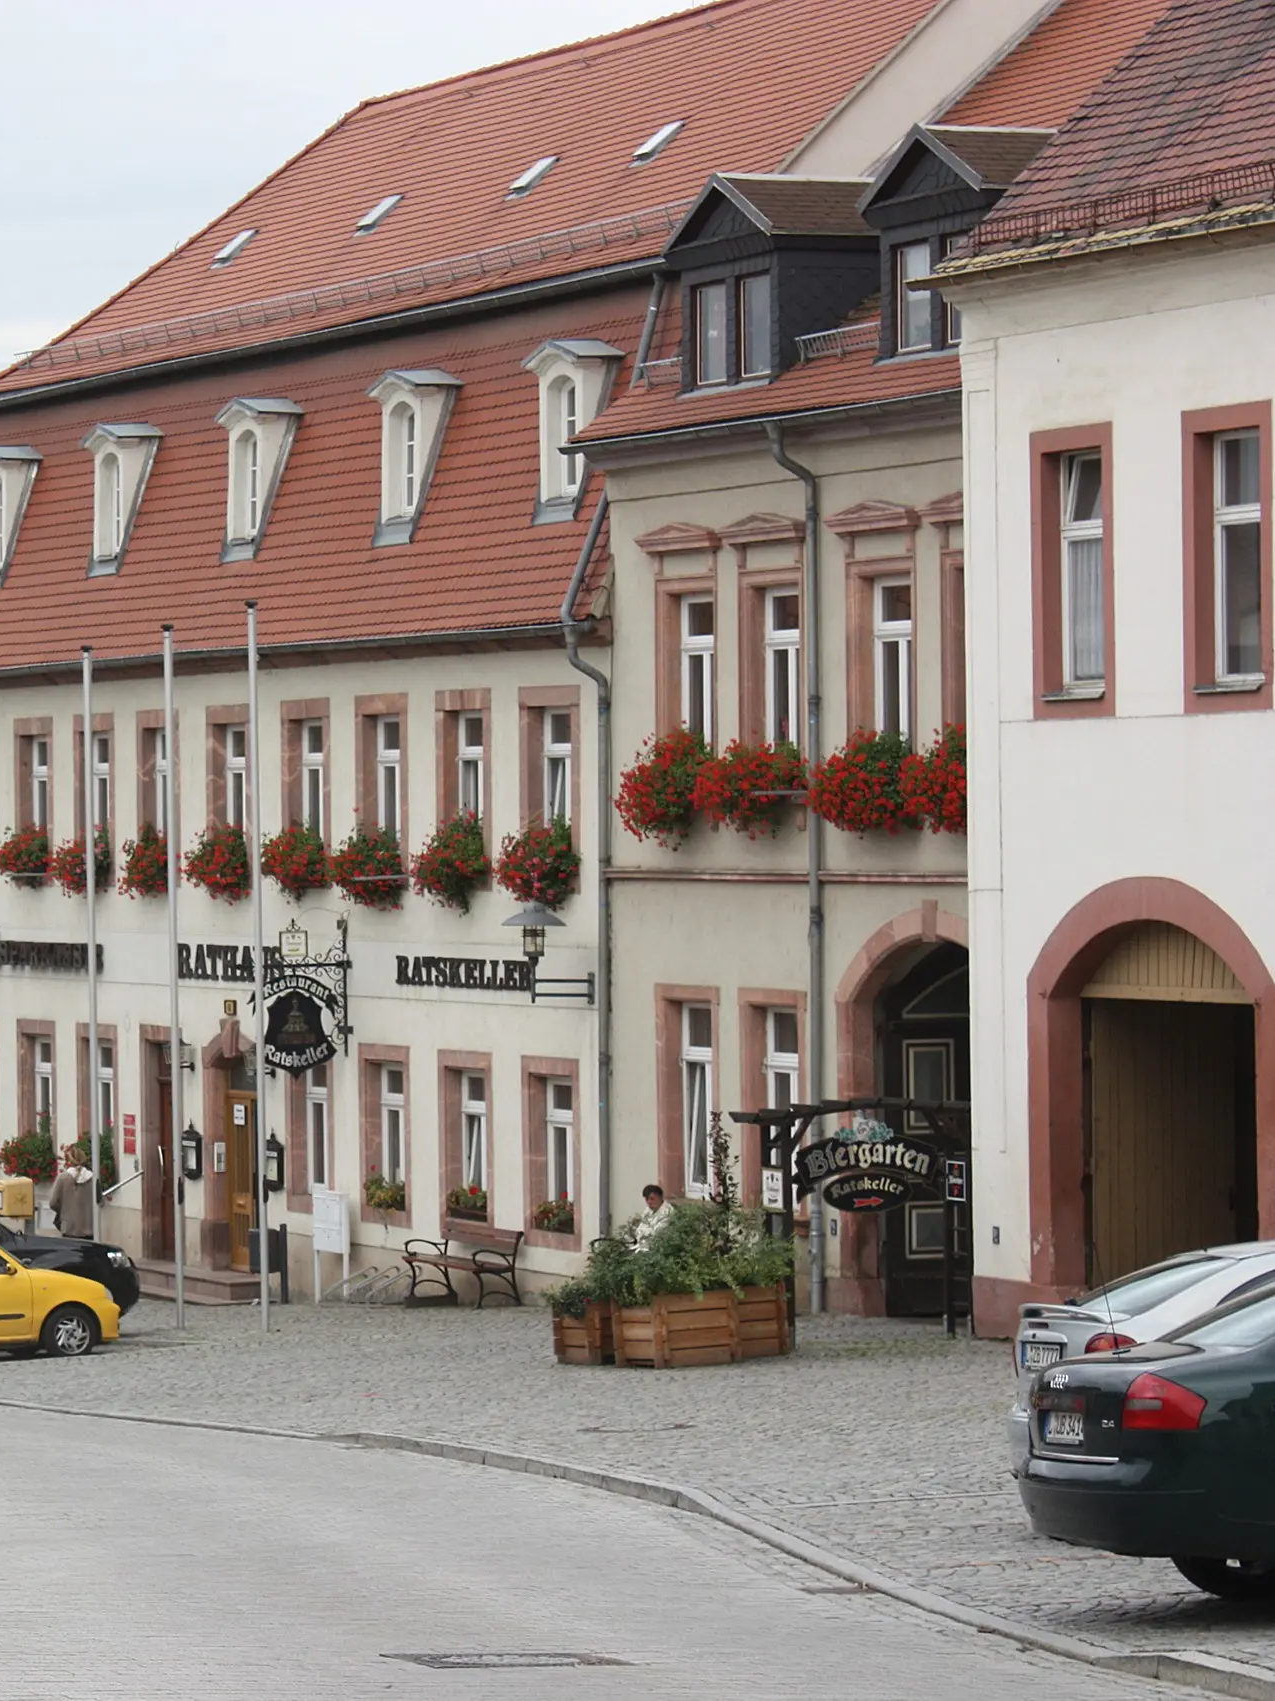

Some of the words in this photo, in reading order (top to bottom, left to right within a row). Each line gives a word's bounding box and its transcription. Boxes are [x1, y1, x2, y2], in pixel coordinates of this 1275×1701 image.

[395, 955, 532, 991] RATSKELLER
[264, 976, 330, 1000] Restaurant
[264, 1042, 329, 1068] Ratskeller
[804, 1142, 931, 1179] Biergarten
[830, 1176, 905, 1199] Ratskeller
